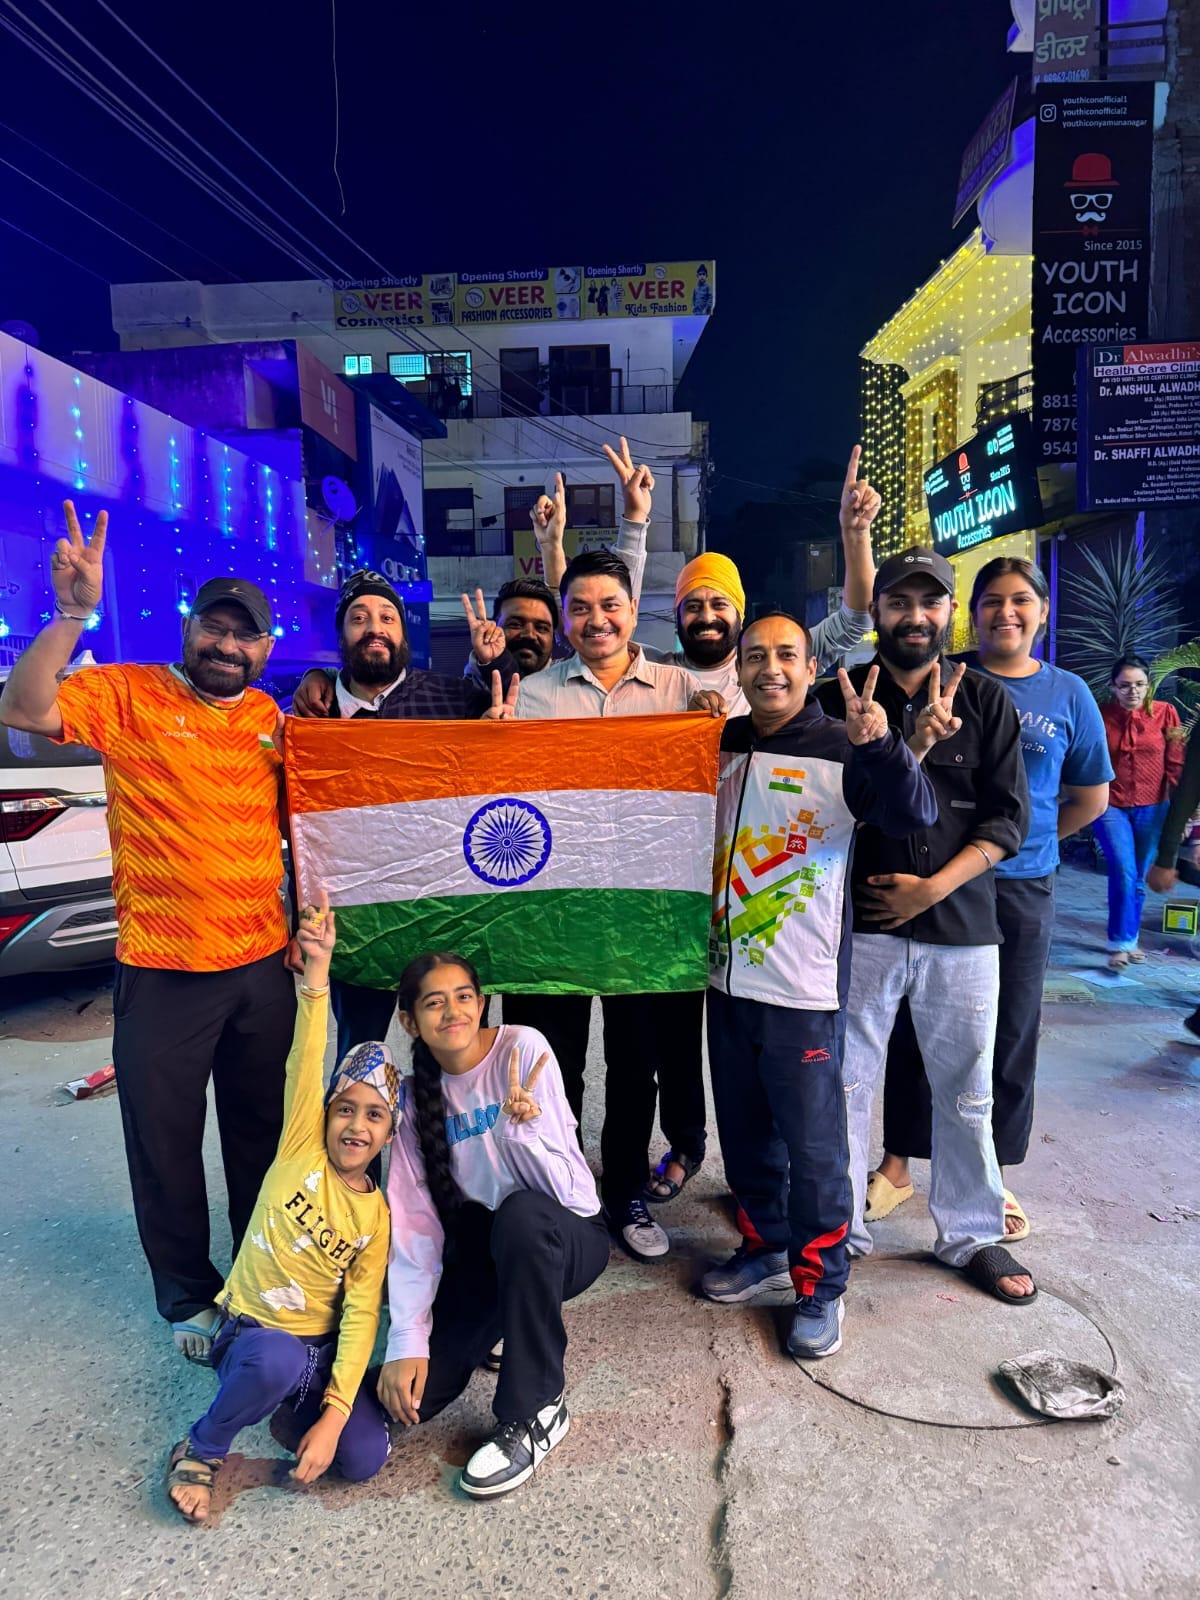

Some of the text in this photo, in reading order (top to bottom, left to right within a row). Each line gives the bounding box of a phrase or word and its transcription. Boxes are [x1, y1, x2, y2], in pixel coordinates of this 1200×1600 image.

[1035, 32, 1089, 63] डीलर
[1063, 95, 1127, 105] youthiconofficial1
[1063, 107, 1127, 117] youthiconofficial2
[1062, 119, 1148, 128] youthiconyamunanagar
[1084, 239, 1143, 251] Since 2015
[462, 269, 544, 282] Opening Shortly
[587, 264, 643, 276] Opening Shortly
[1041, 259, 1138, 285] YOUTH
[489, 285, 545, 306] VEER
[628, 280, 686, 300] VEER
[364, 291, 423, 311] VEER
[1053, 291, 1126, 315] ICON
[462, 307, 553, 322] FASHION ACCESSORIES
[625, 302, 687, 316] Kids Fashion
[337, 314, 425, 327] Cosmetics
[1042, 322, 1137, 345] Accessories
[1099, 352, 1121, 363] Dr
[1095, 366, 1135, 376] Health
[1138, 364, 1167, 374] Care
[1099, 386, 1112, 397] Dr.
[1115, 383, 1156, 395] ANSHUL
[1094, 450, 1108, 460] Dr.
[1111, 447, 1150, 460] SHAFFI
[935, 498, 976, 542] YOUTH
[975, 480, 1016, 524] ICON
[958, 524, 993, 549] Accessories
